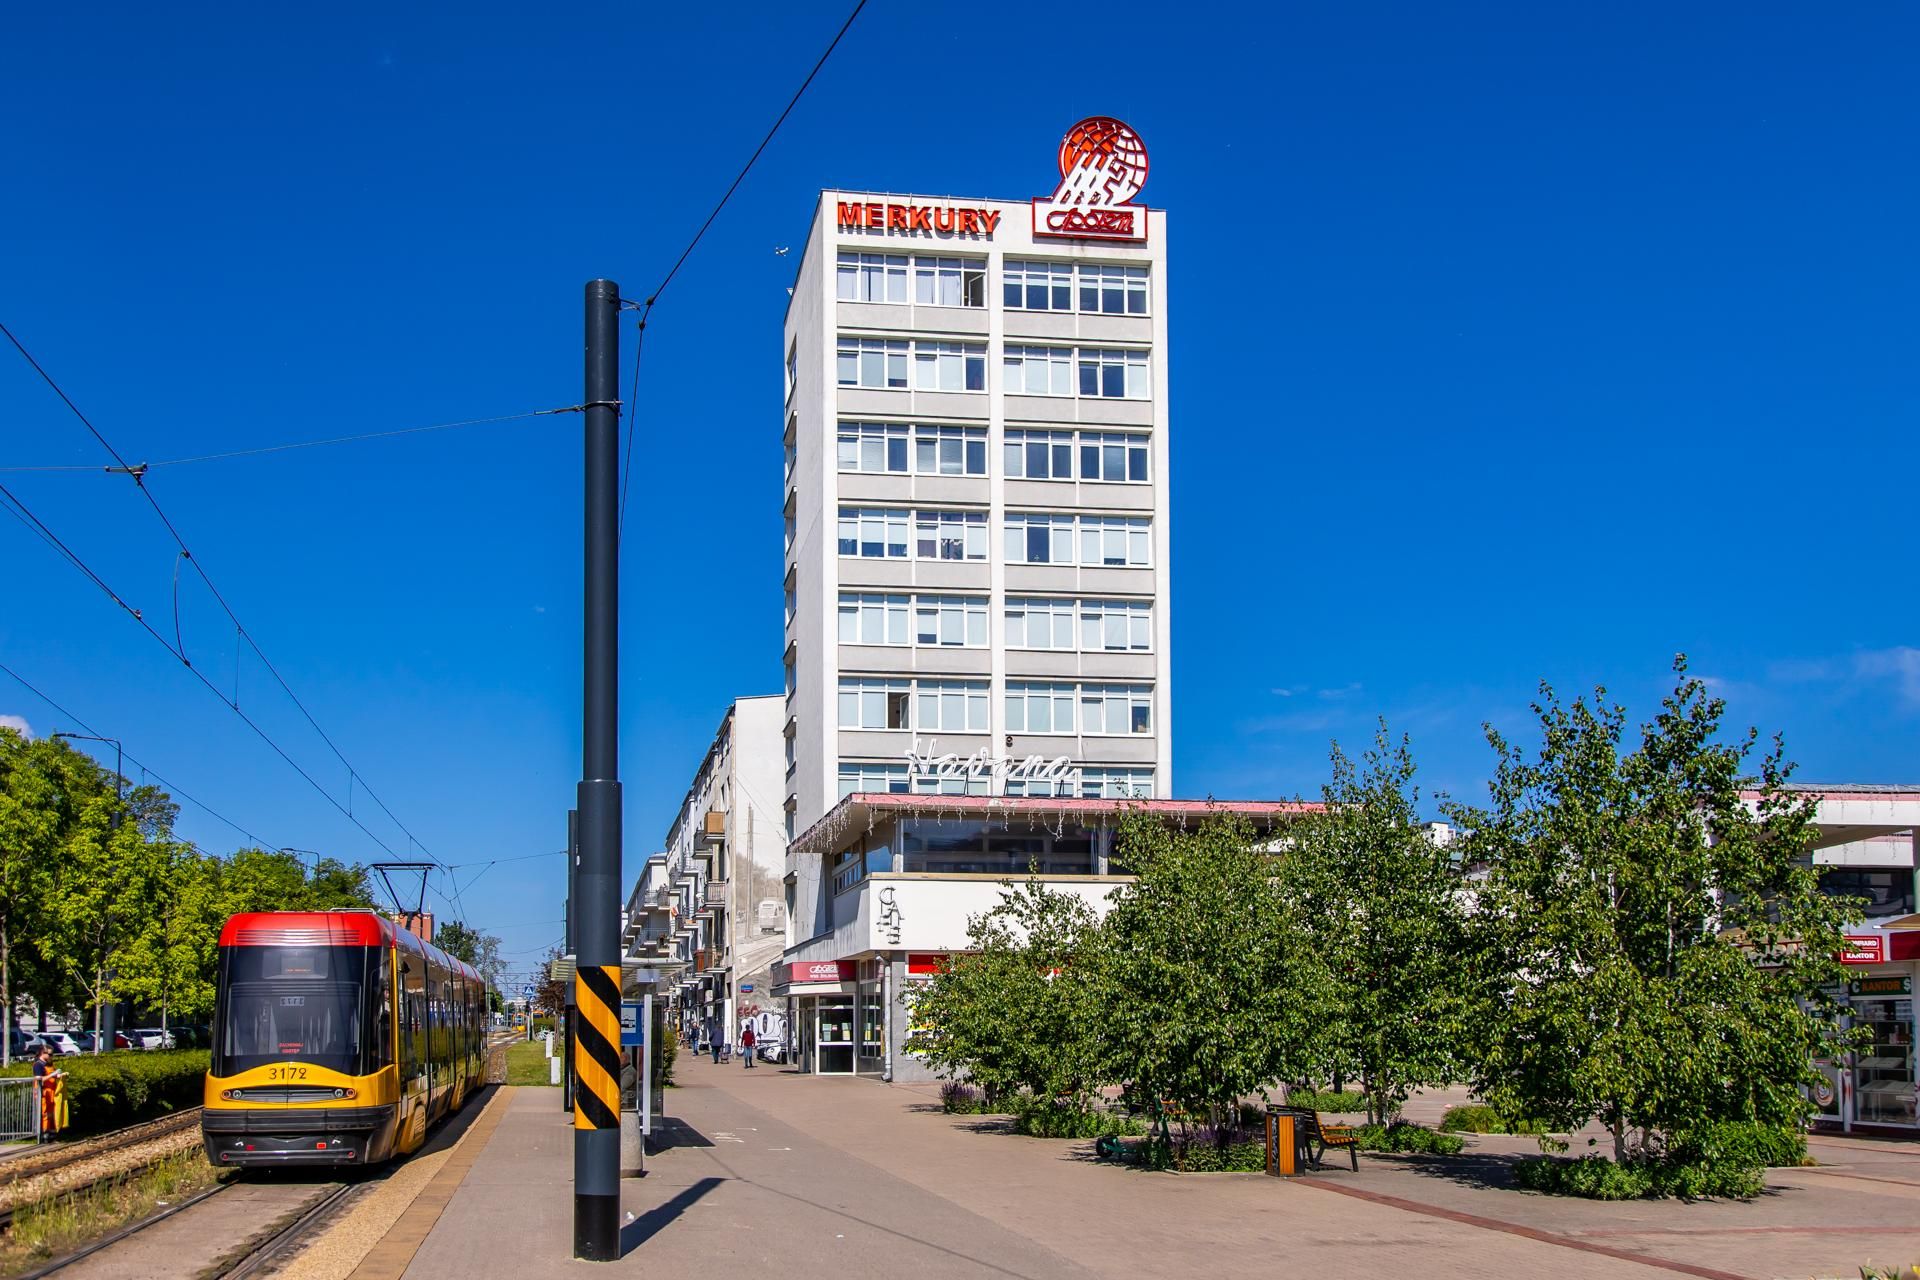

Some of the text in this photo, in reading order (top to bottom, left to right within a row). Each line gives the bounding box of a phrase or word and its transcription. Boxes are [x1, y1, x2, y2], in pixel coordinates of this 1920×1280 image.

[838, 201, 1001, 234] MERKURY
[1862, 980, 1901, 992] KANTOR
[268, 1067, 307, 1080] 3172
